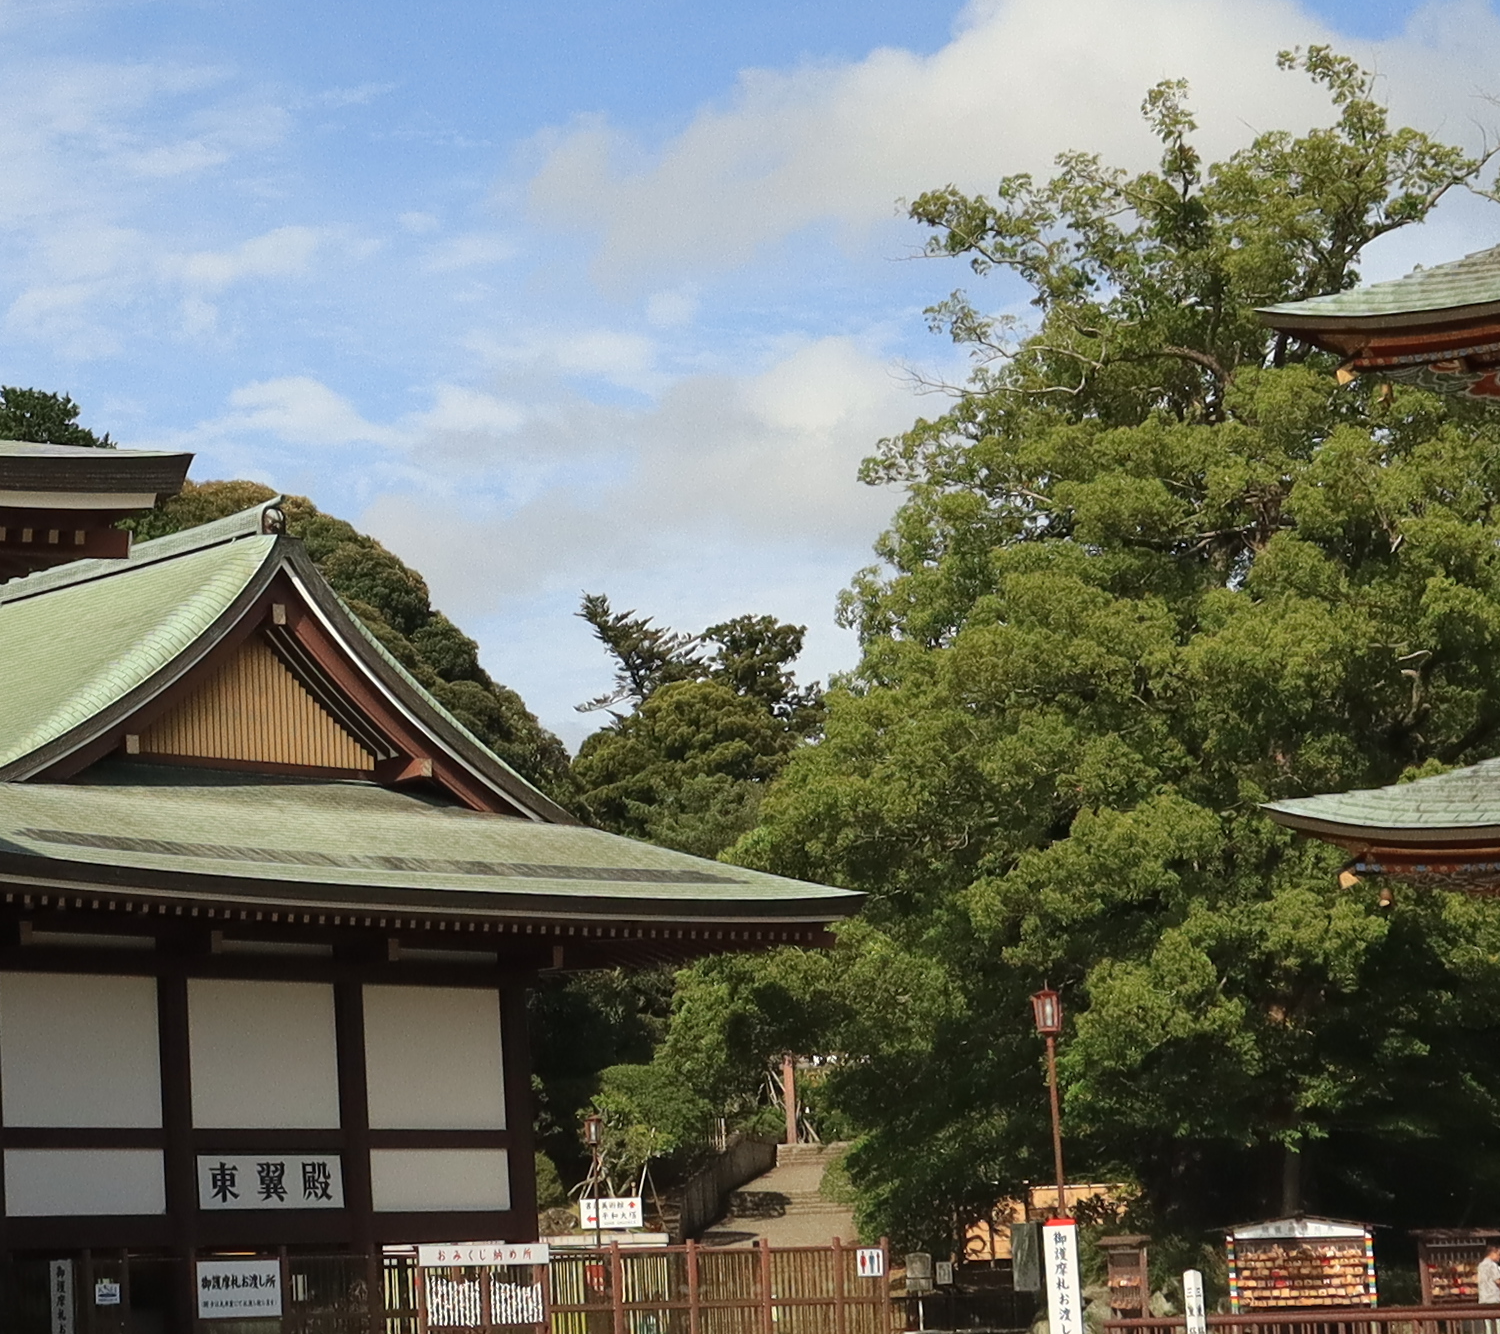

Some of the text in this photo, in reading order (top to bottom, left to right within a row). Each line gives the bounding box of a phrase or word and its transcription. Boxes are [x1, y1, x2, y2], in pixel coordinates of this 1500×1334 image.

[209, 1160, 333, 1204] 東翼殿
[585, 1201, 624, 1210] 書美術館
[603, 1211, 637, 1220] 平和大塔
[437, 1248, 532, 1262] おみくじ納め所
[201, 1273, 276, 1291] 御護摩札お渡し所
